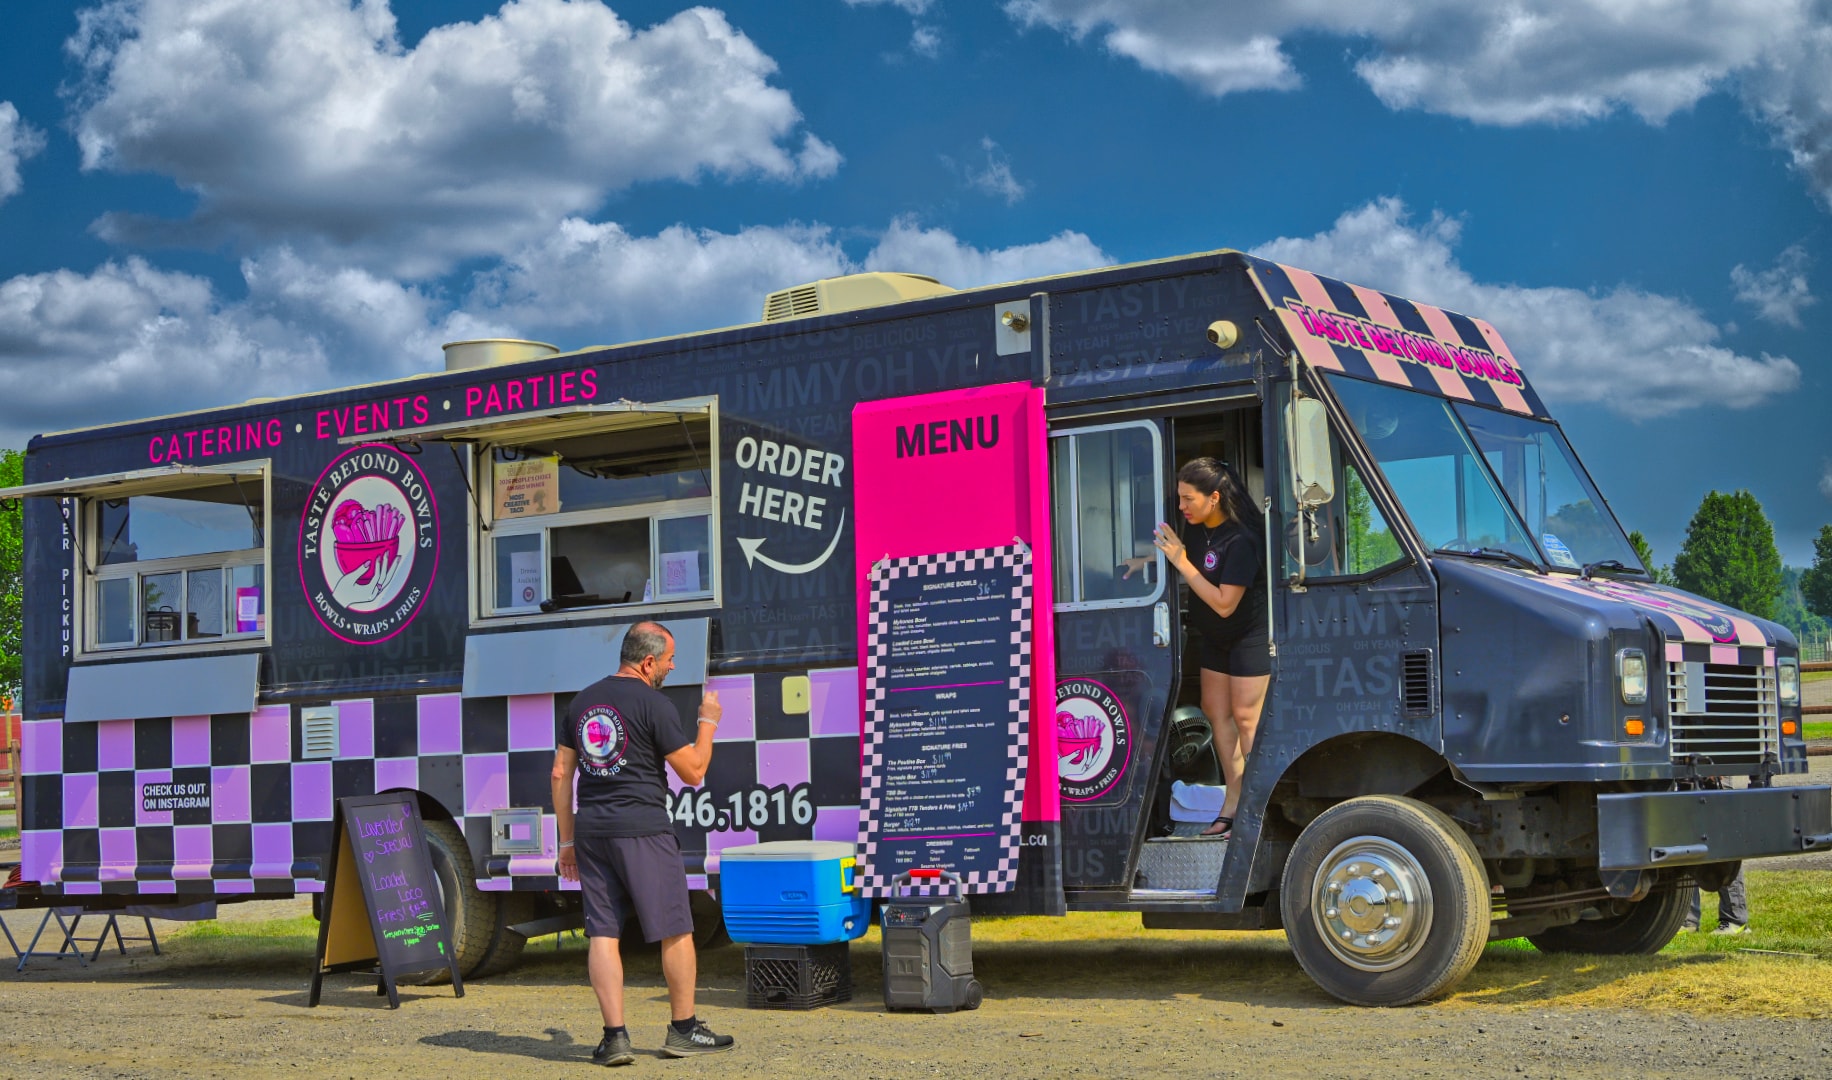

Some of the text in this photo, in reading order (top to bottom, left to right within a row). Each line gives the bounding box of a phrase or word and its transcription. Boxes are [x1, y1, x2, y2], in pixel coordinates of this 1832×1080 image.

[1286, 301, 1523, 387] TASTE BEYOND BOWLS
[149, 368, 598, 463] CATERING EVENTS PARTIES
[897, 415, 1000, 458] MENU
[735, 435, 846, 488] ORDER
[509, 493, 525, 501] MOST
[526, 481, 545, 489] WINNER
[62, 477, 70, 550] RDER
[305, 453, 432, 558] TASTE BEYOND BOWLS
[504, 499, 530, 508] CREATIVE
[510, 506, 524, 514] TACO
[738, 482, 827, 531] HERE
[923, 579, 977, 590] SIGNATURE BOWLS
[62, 568, 70, 657] PICKUP
[315, 586, 421, 636] BOWLS WRAPS FRIES
[1304, 653, 1399, 697] TAS
[588, 706, 614, 718] BEYOND
[612, 715, 624, 741] BOWLS
[1102, 695, 1126, 745] BOWLS
[922, 743, 951, 751] SIGNATURE
[143, 783, 206, 796] CHECK US OUT
[1068, 767, 1118, 796] WRAPS FRIES
[143, 797, 210, 810] ON INSTAGRAM
[355, 815, 405, 839] Lavender
[375, 833, 413, 856] Special
[372, 870, 409, 892] Loaded
[397, 887, 424, 904] Loco
[690, 1032, 716, 1046] HOKA
